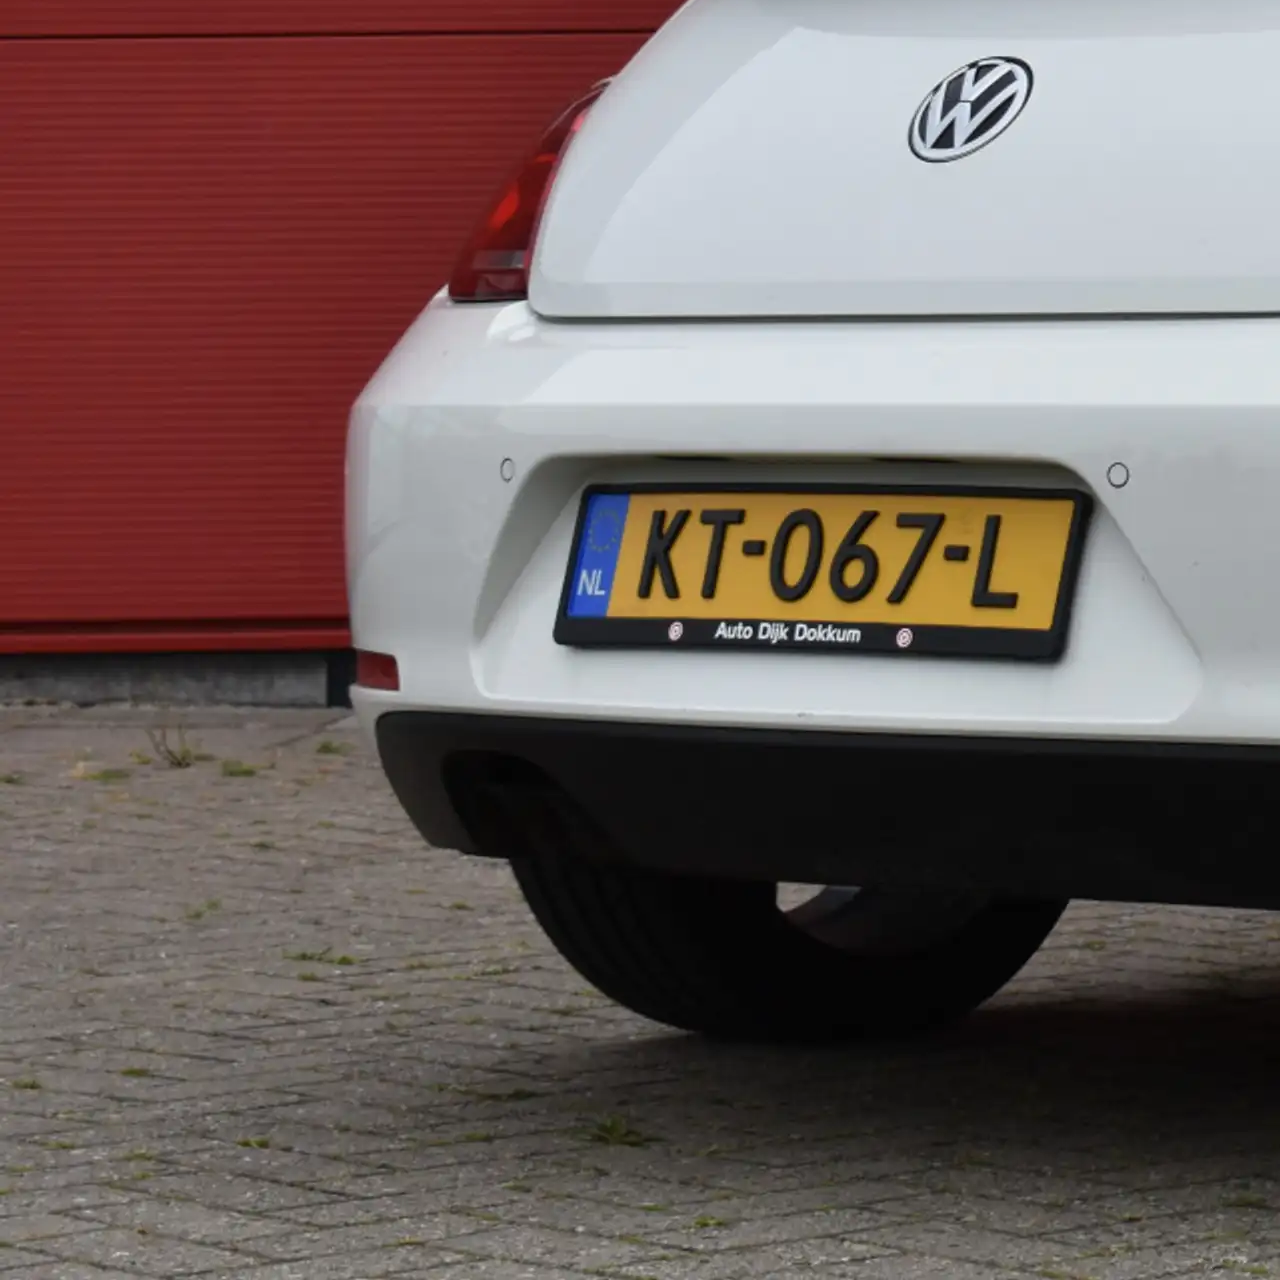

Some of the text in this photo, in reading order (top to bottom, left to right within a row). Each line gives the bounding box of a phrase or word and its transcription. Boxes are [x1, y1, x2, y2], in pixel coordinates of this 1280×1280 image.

[637, 508, 1020, 609] KT-067-L
[576, 569, 606, 596] NL
[714, 621, 862, 645] Auto Dijk Dokkum
